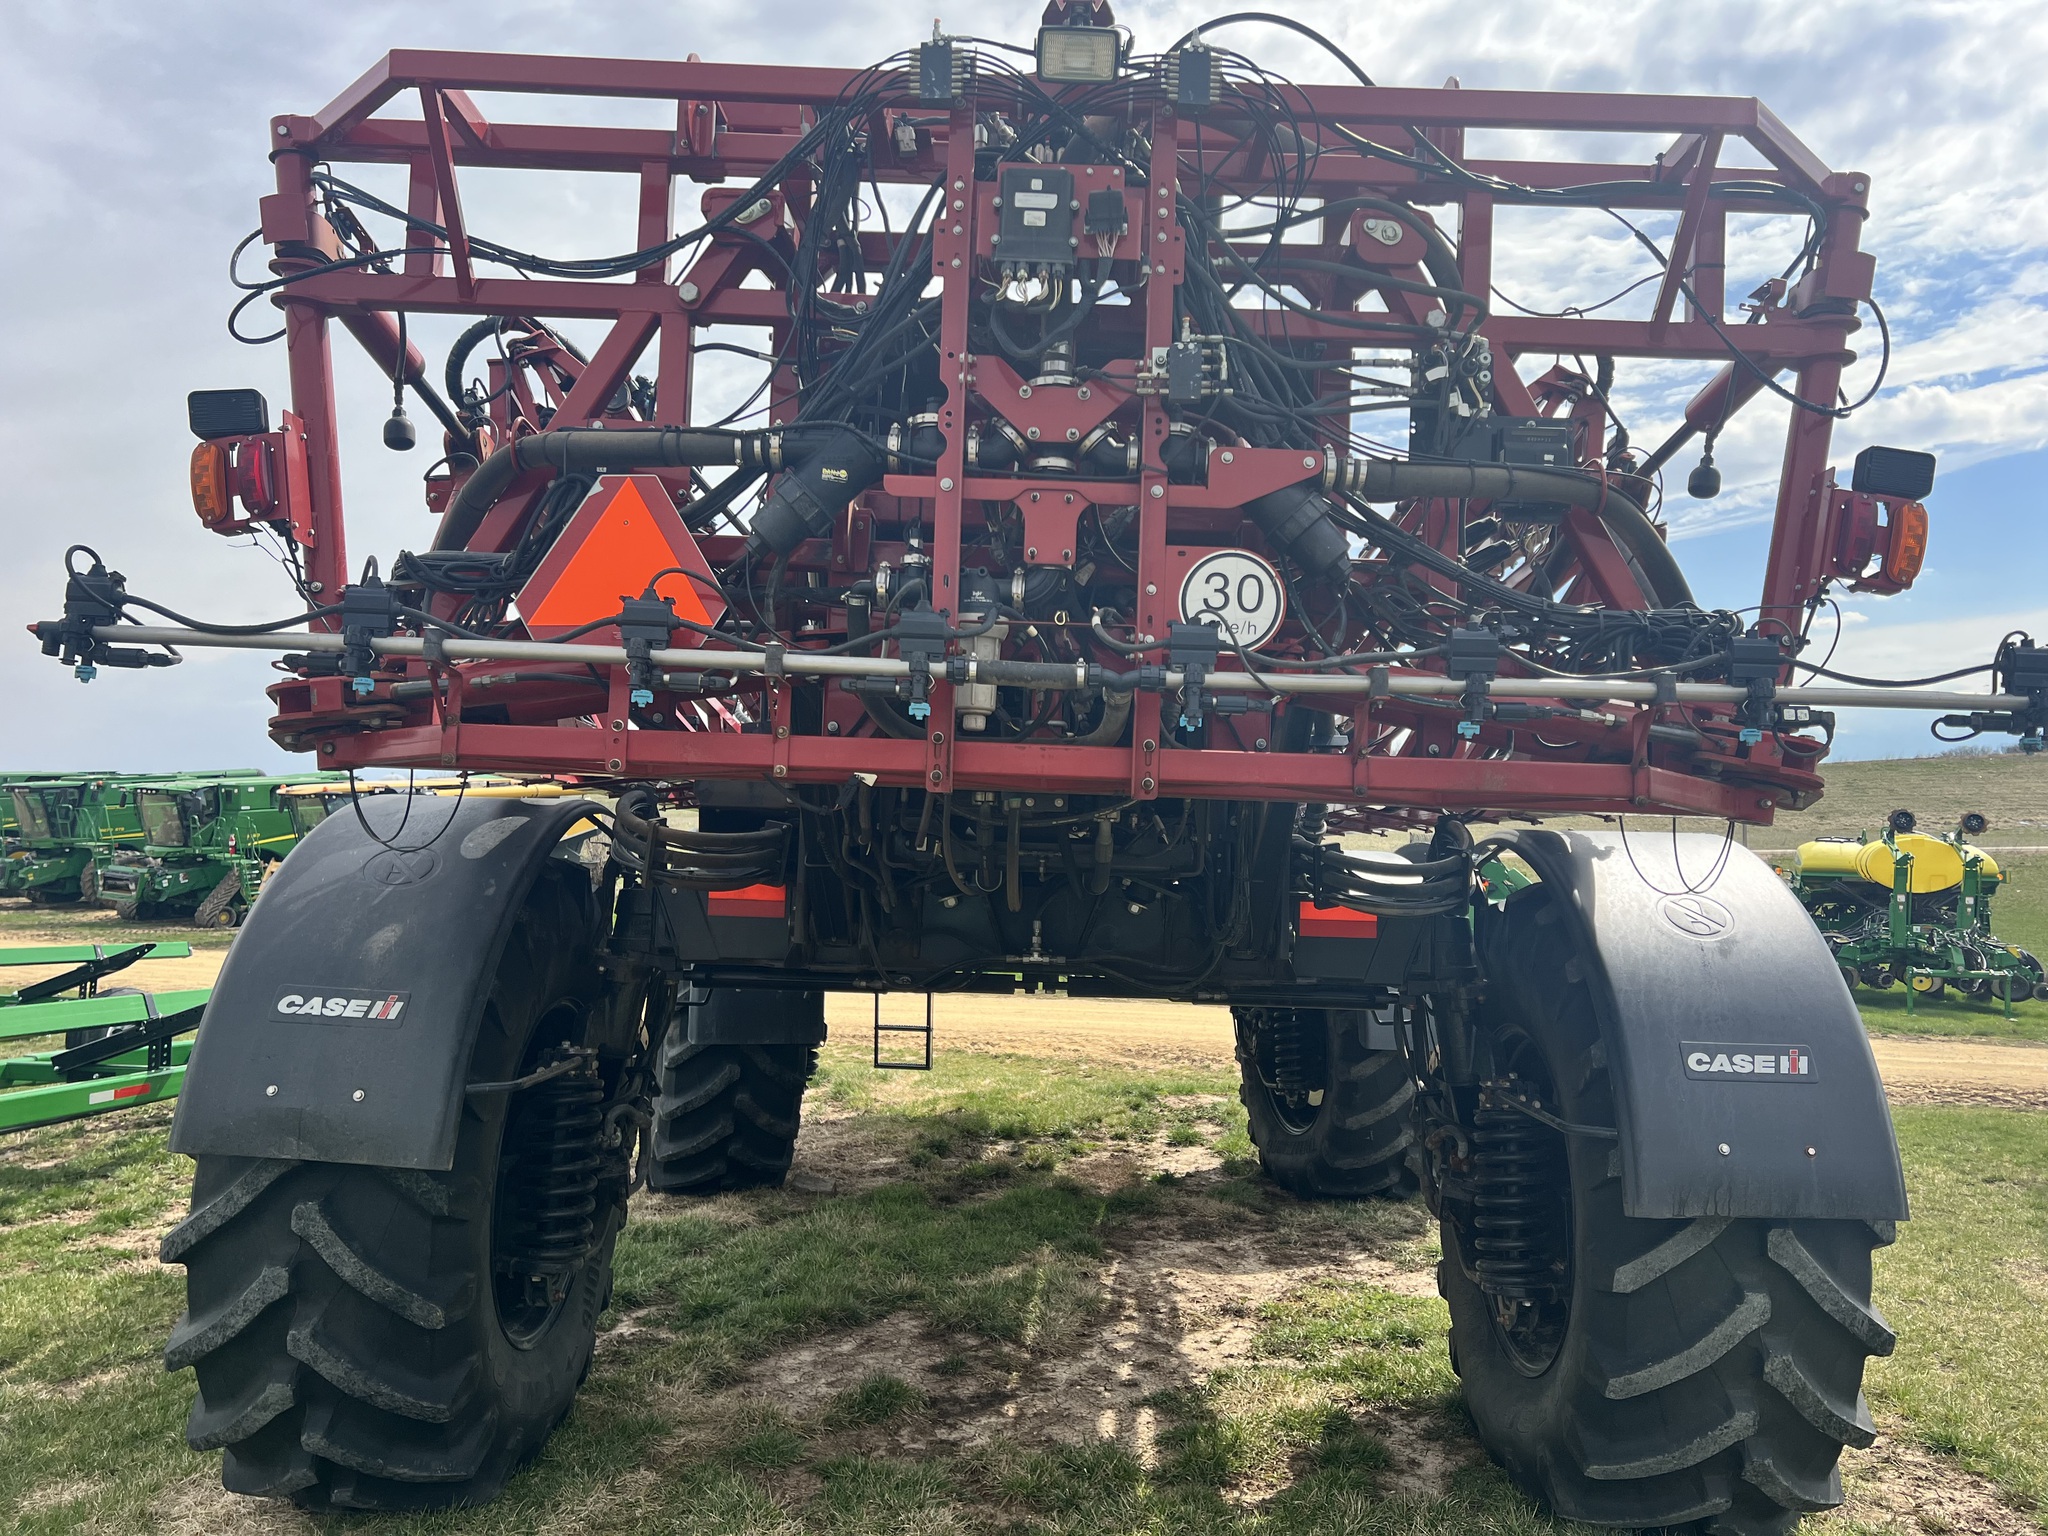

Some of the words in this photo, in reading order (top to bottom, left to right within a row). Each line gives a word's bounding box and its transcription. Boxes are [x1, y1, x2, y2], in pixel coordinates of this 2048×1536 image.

[1202, 571, 1265, 614] 30
[277, 994, 372, 1019] CASE
[1687, 1052, 1776, 1074] CASE
